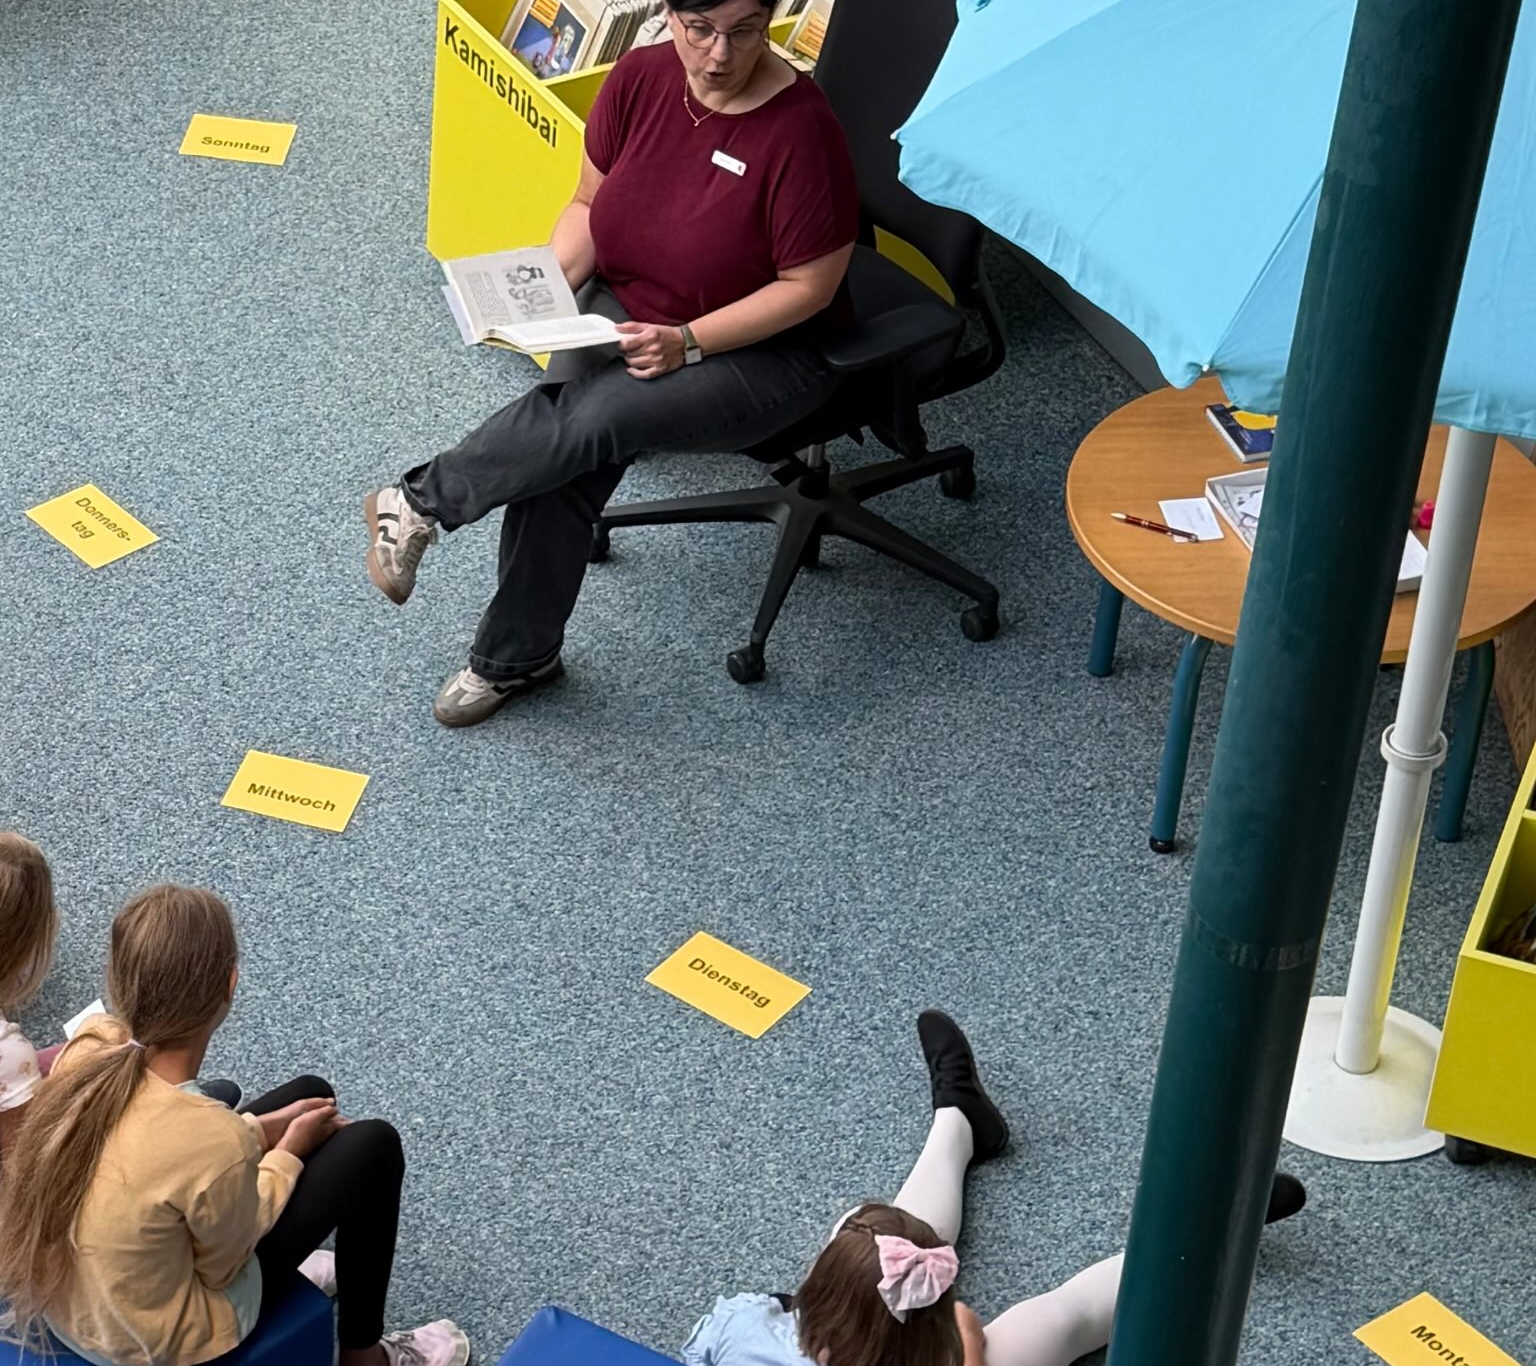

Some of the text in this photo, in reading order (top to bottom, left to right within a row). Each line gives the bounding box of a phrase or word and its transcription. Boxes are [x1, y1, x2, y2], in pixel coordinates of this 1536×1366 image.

[444, 17, 558, 148] Kamishibai
[201, 136, 270, 153] Sonntag
[71, 520, 95, 539] tag
[75, 497, 131, 542] Donners-
[247, 782, 336, 812] Mittwoch
[688, 958, 771, 1009] Dienstag
